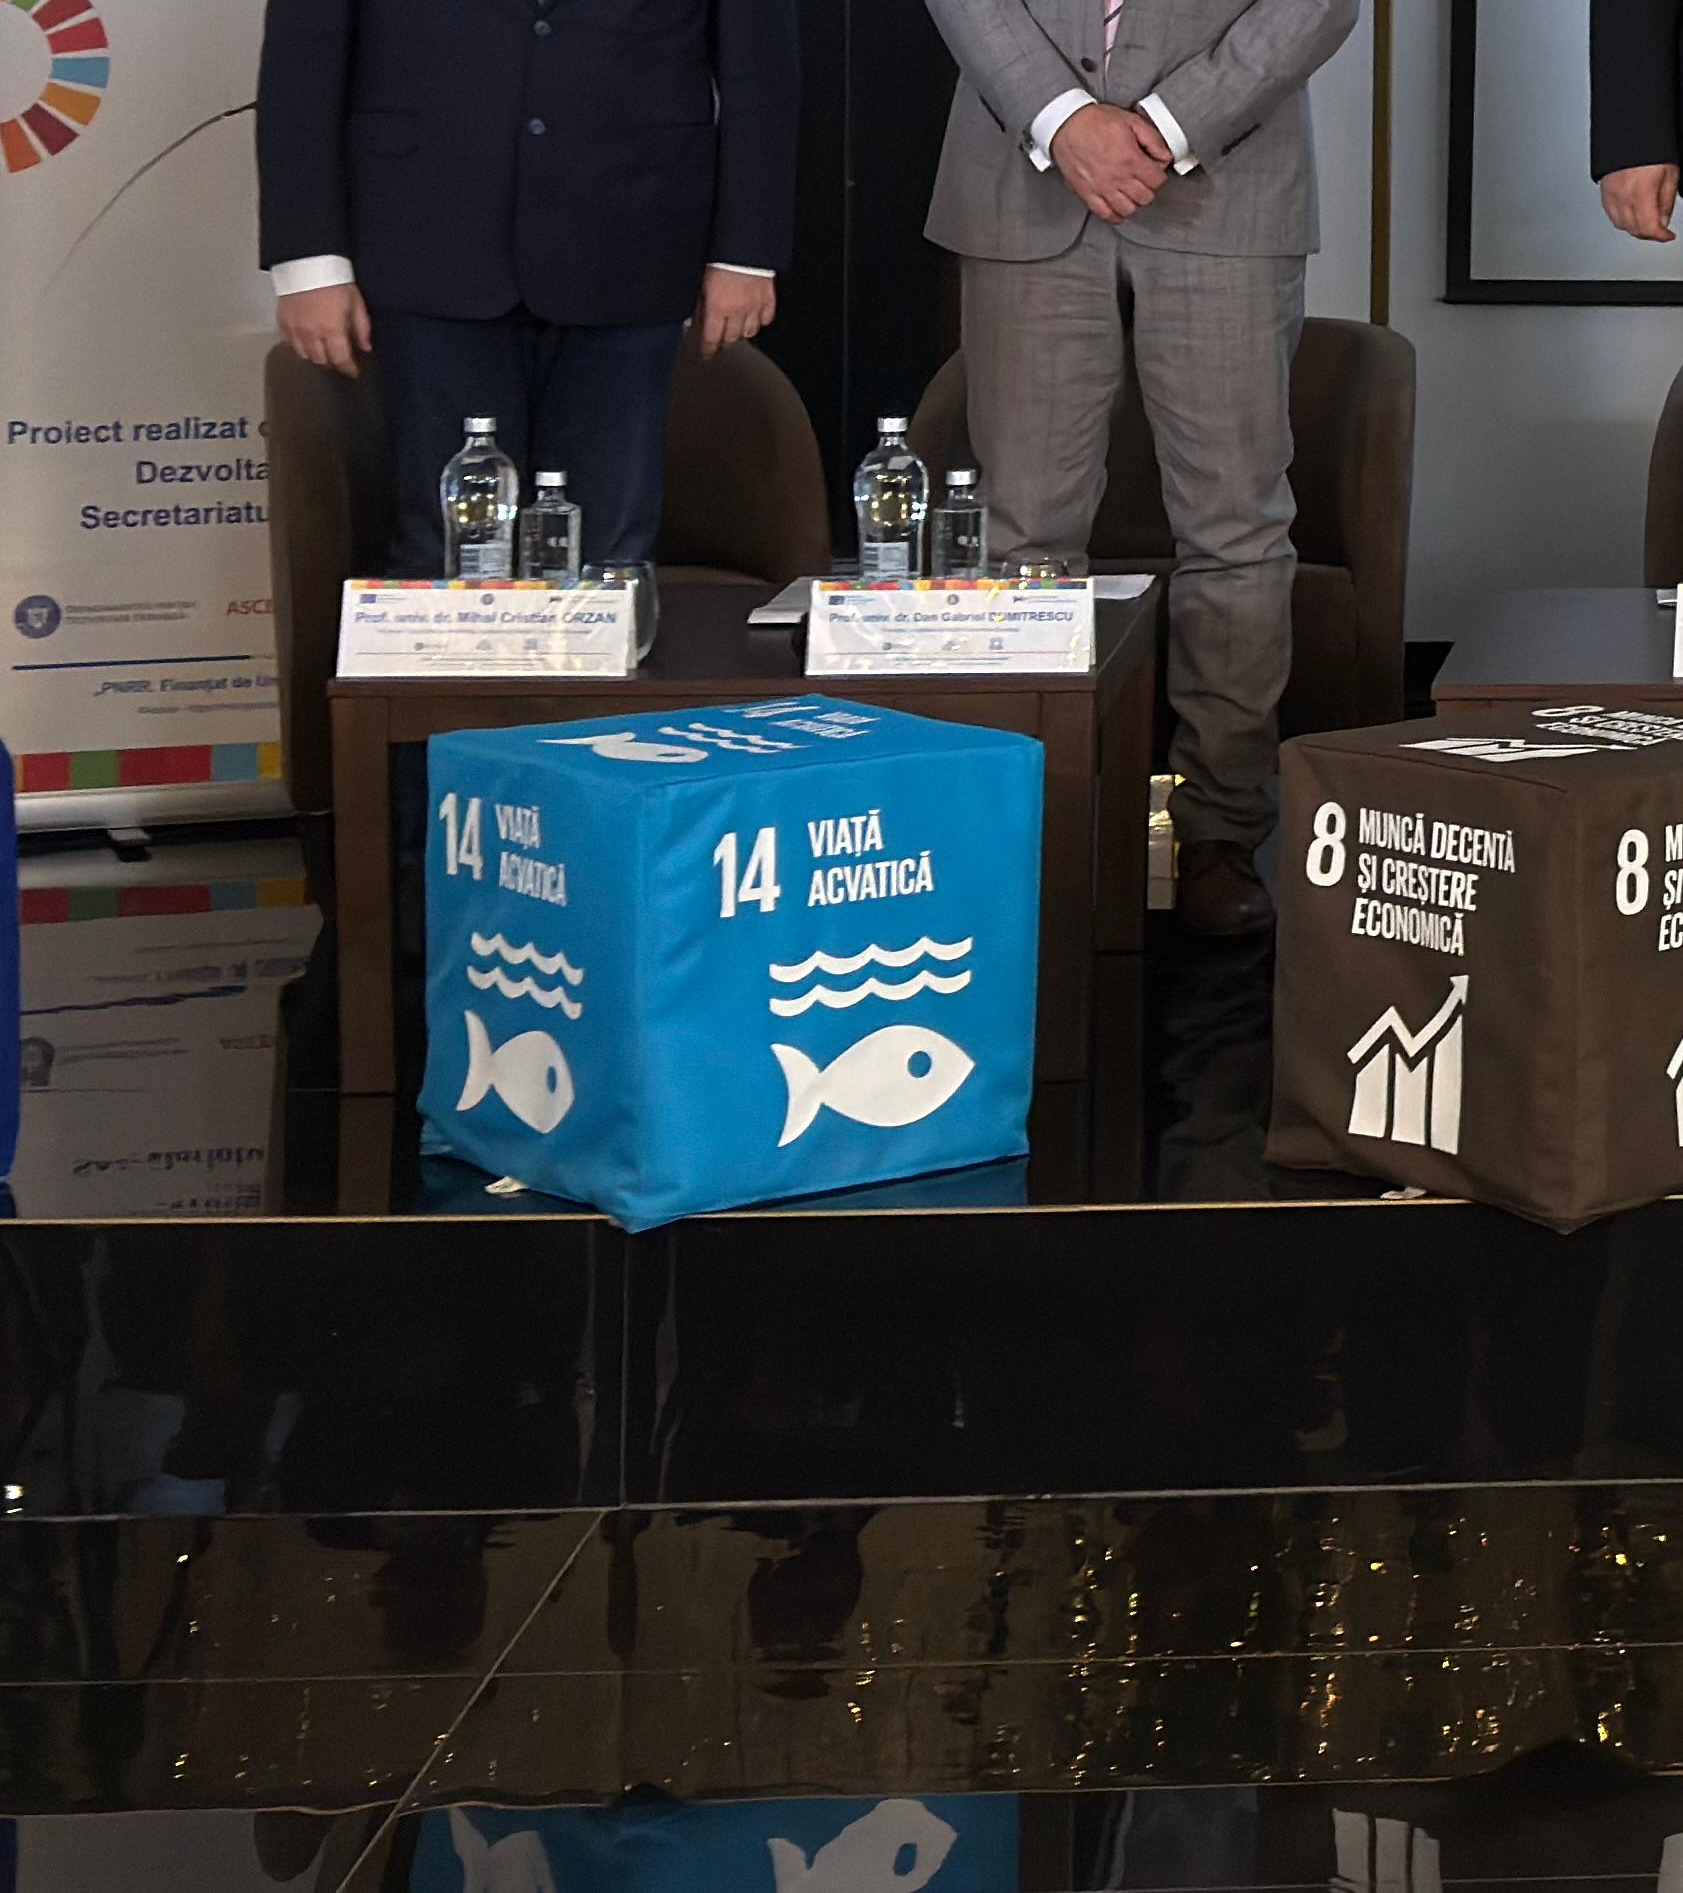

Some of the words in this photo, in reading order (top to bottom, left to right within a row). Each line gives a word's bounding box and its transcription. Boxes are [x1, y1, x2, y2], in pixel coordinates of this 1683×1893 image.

[7, 420, 123, 444] Proiect
[133, 416, 248, 442] realizat
[136, 458, 269, 485] Dezvolta
[80, 501, 269, 530] Secretariatu
[440, 792, 484, 880] 14
[808, 809, 883, 858] VIAȚĂ
[1305, 801, 1347, 887] 8
[1359, 808, 1425, 856] MUNCĂ
[1430, 818, 1516, 874] DECENTĂ
[713, 827, 781, 918] 14
[808, 851, 934, 907] ACVATICĂ
[1357, 854, 1377, 892] ȘI
[1381, 857, 1479, 912] CREȘTERE
[1616, 829, 1650, 916] 8
[1351, 898, 1465, 957] ECONOMICĂ
